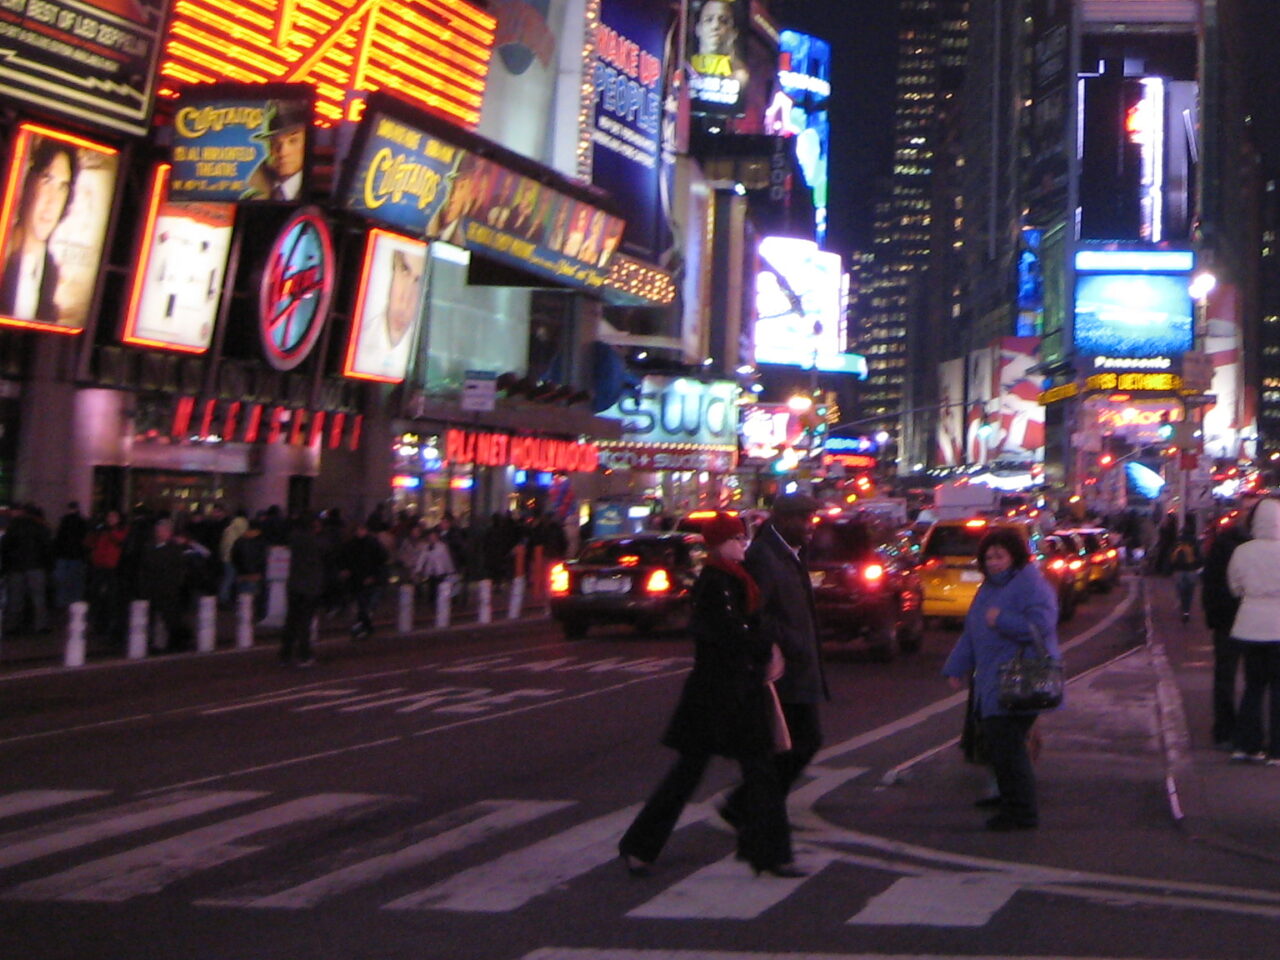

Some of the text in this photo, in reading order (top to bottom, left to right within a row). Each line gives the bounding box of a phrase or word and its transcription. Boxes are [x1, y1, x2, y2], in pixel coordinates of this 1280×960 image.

[1094, 355, 1172, 369] Panasonic
[447, 428, 600, 473] PLANET HOLLYWOOD
